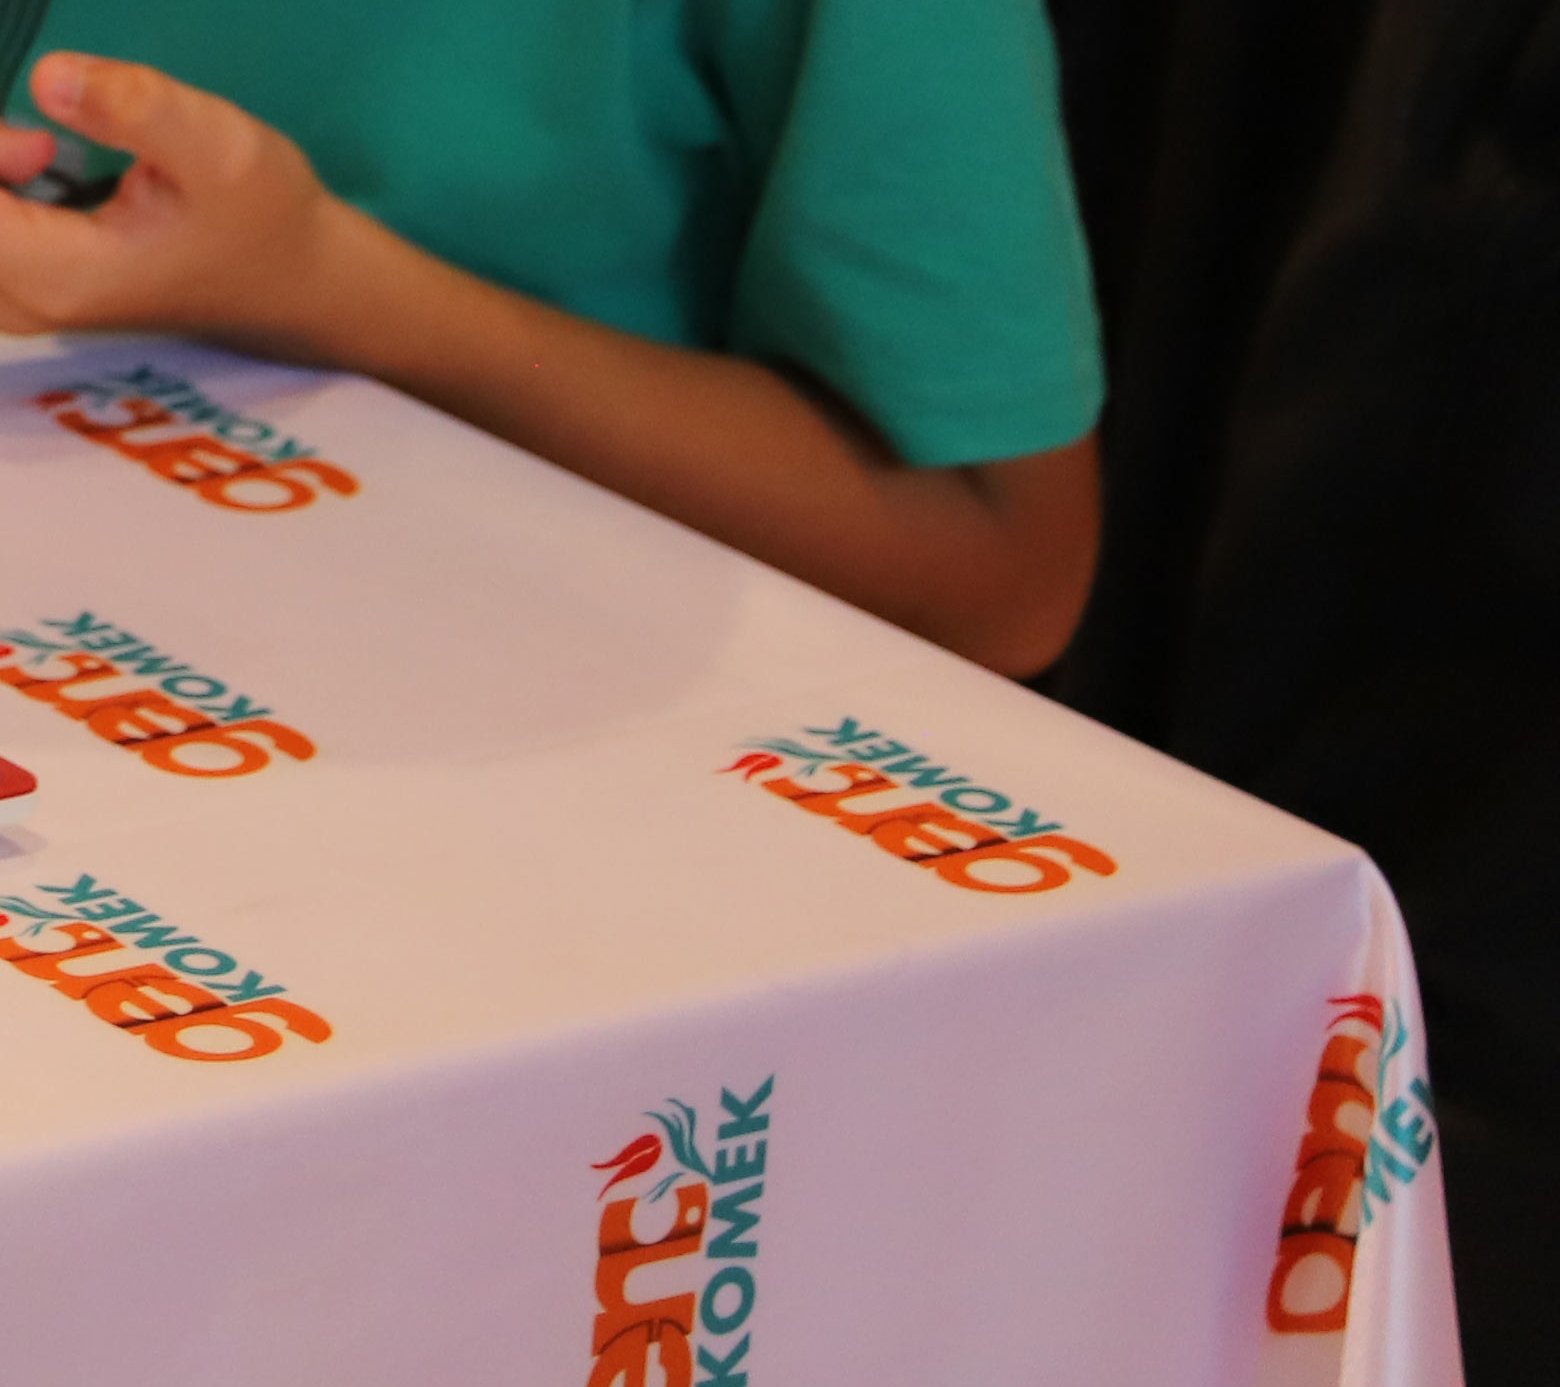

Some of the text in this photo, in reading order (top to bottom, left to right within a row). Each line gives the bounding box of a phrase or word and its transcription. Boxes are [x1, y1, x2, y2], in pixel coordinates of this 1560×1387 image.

[39, 611, 274, 722] KOMEK
[803, 716, 1064, 838] KOMEK
[34, 873, 288, 1003] KOMEK
[695, 1074, 774, 1387] KOMEK
